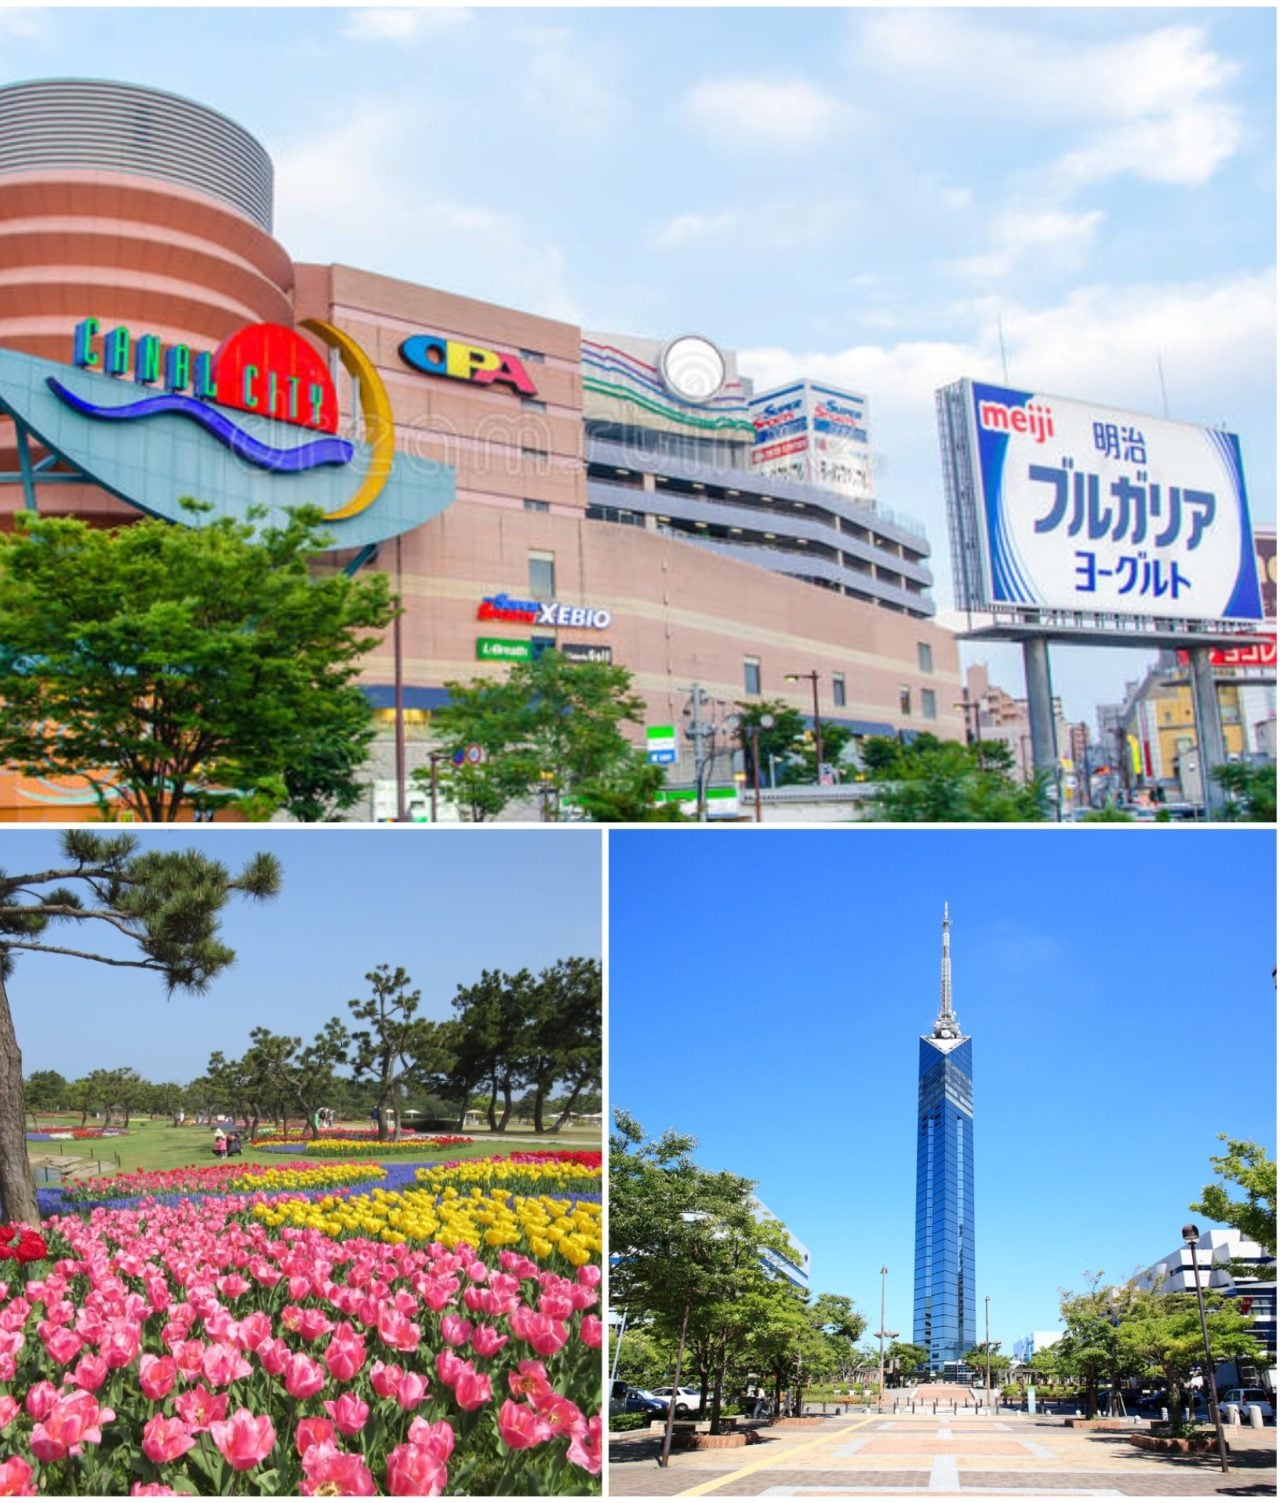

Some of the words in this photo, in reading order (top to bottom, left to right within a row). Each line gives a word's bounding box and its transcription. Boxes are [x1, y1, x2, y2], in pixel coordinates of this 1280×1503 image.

[73, 316, 216, 399] CANAL
[242, 363, 323, 424] CITY
[398, 334, 538, 398] OPA
[981, 401, 1055, 444] meiji
[1092, 421, 1147, 464] 明治
[1028, 456, 1217, 551] ブルガリア
[1074, 550, 1192, 600] ヨーグルト
[537, 601, 613, 629] XEBIO
